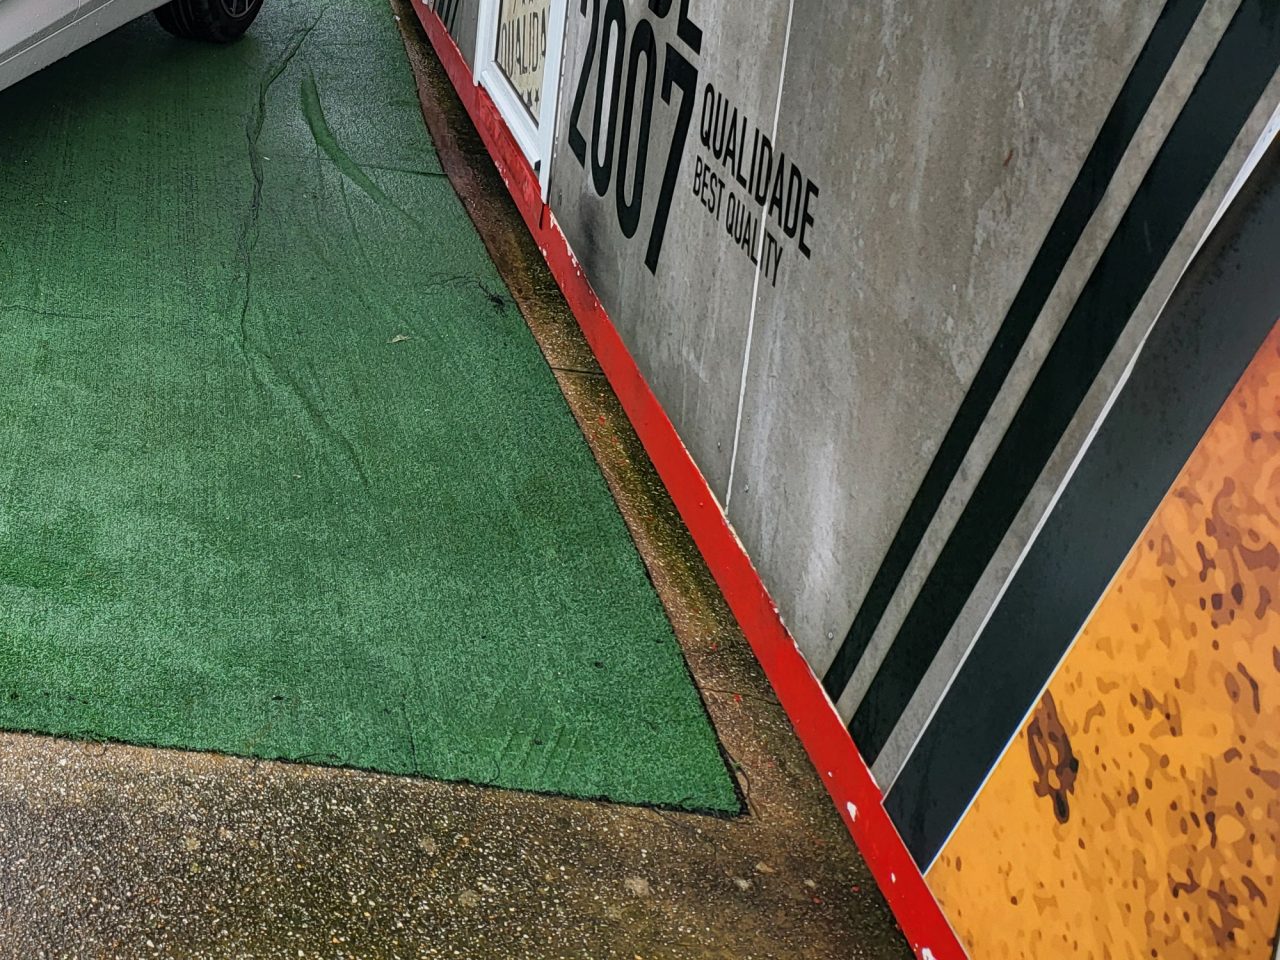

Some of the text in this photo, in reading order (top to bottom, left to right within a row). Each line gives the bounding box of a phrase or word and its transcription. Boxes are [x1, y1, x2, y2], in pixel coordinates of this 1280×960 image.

[501, 4, 551, 79] QUALIDA
[692, 154, 784, 289] BEST QUALITY
[700, 83, 819, 261] QUALIDADE
